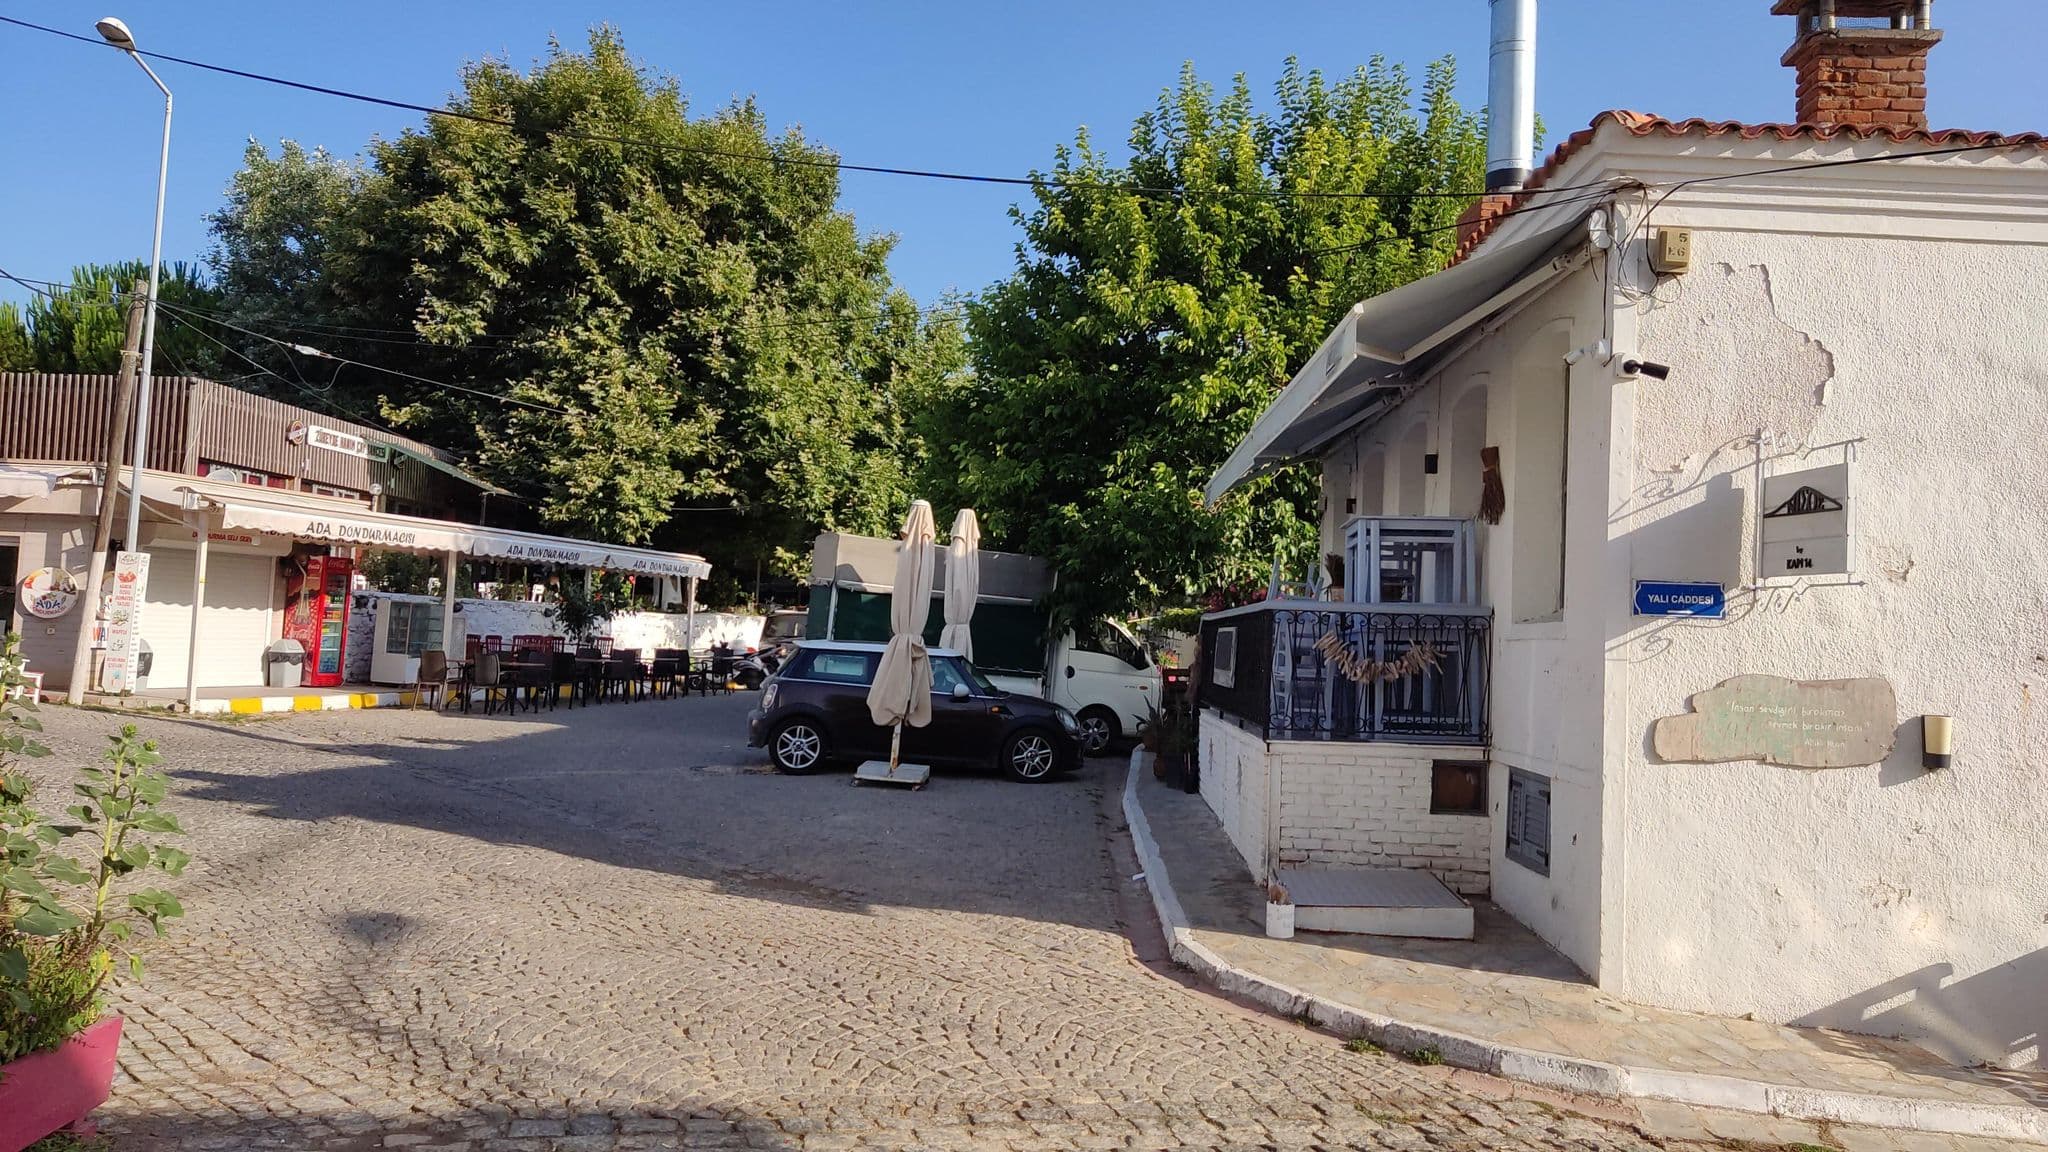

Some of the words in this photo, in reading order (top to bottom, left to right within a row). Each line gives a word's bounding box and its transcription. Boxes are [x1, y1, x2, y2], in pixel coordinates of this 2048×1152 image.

[306, 521, 331, 536] ADA
[338, 525, 416, 544] DONDURMACISI
[506, 545, 523, 555] ADA
[632, 559, 647, 569] ADA
[1648, 594, 1669, 603] YALI
[1671, 594, 1714, 604] CADDESİ
[36, 599, 61, 610] ADA
